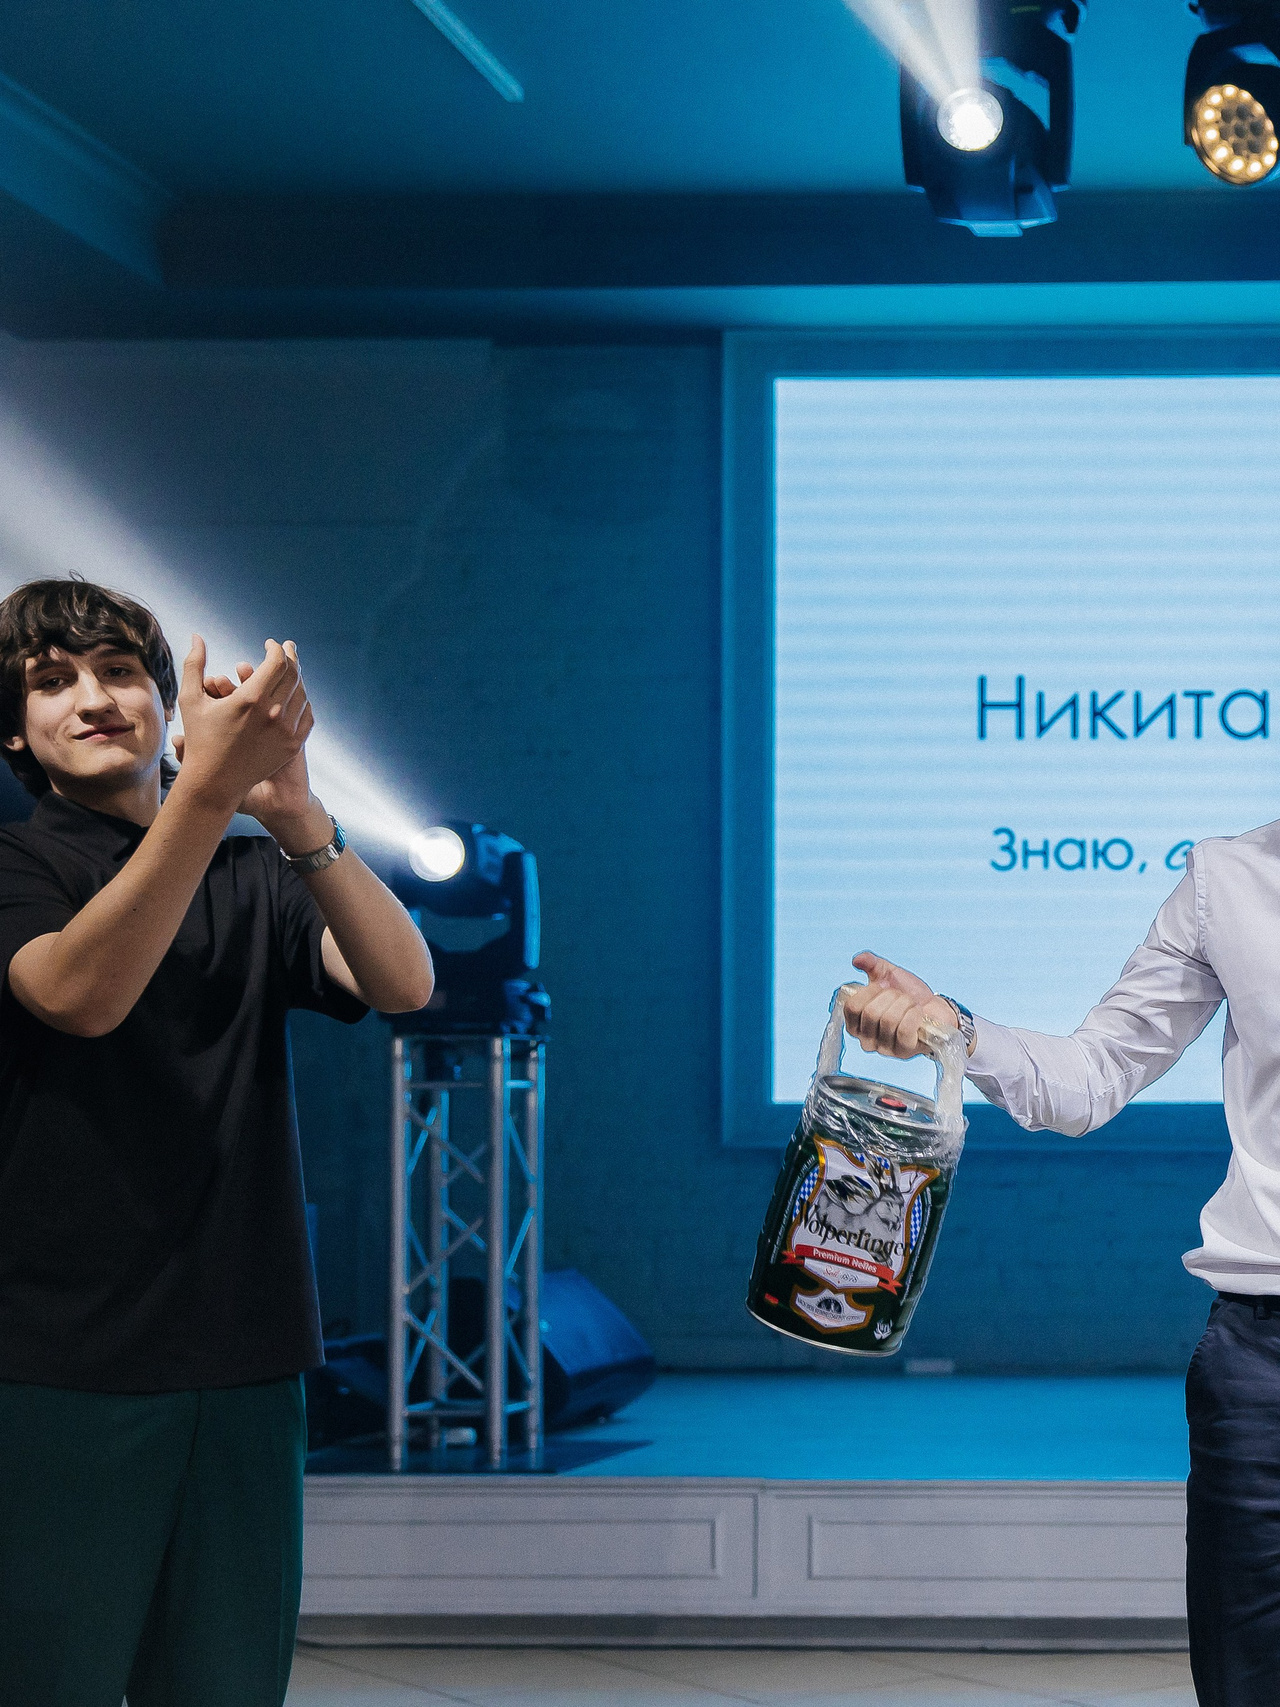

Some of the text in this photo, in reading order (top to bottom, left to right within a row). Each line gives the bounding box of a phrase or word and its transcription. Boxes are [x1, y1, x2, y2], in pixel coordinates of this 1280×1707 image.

[977, 674, 1270, 740] Никита
[990, 827, 1147, 874] Знаю,
[812, 1247, 850, 1266] Premium
